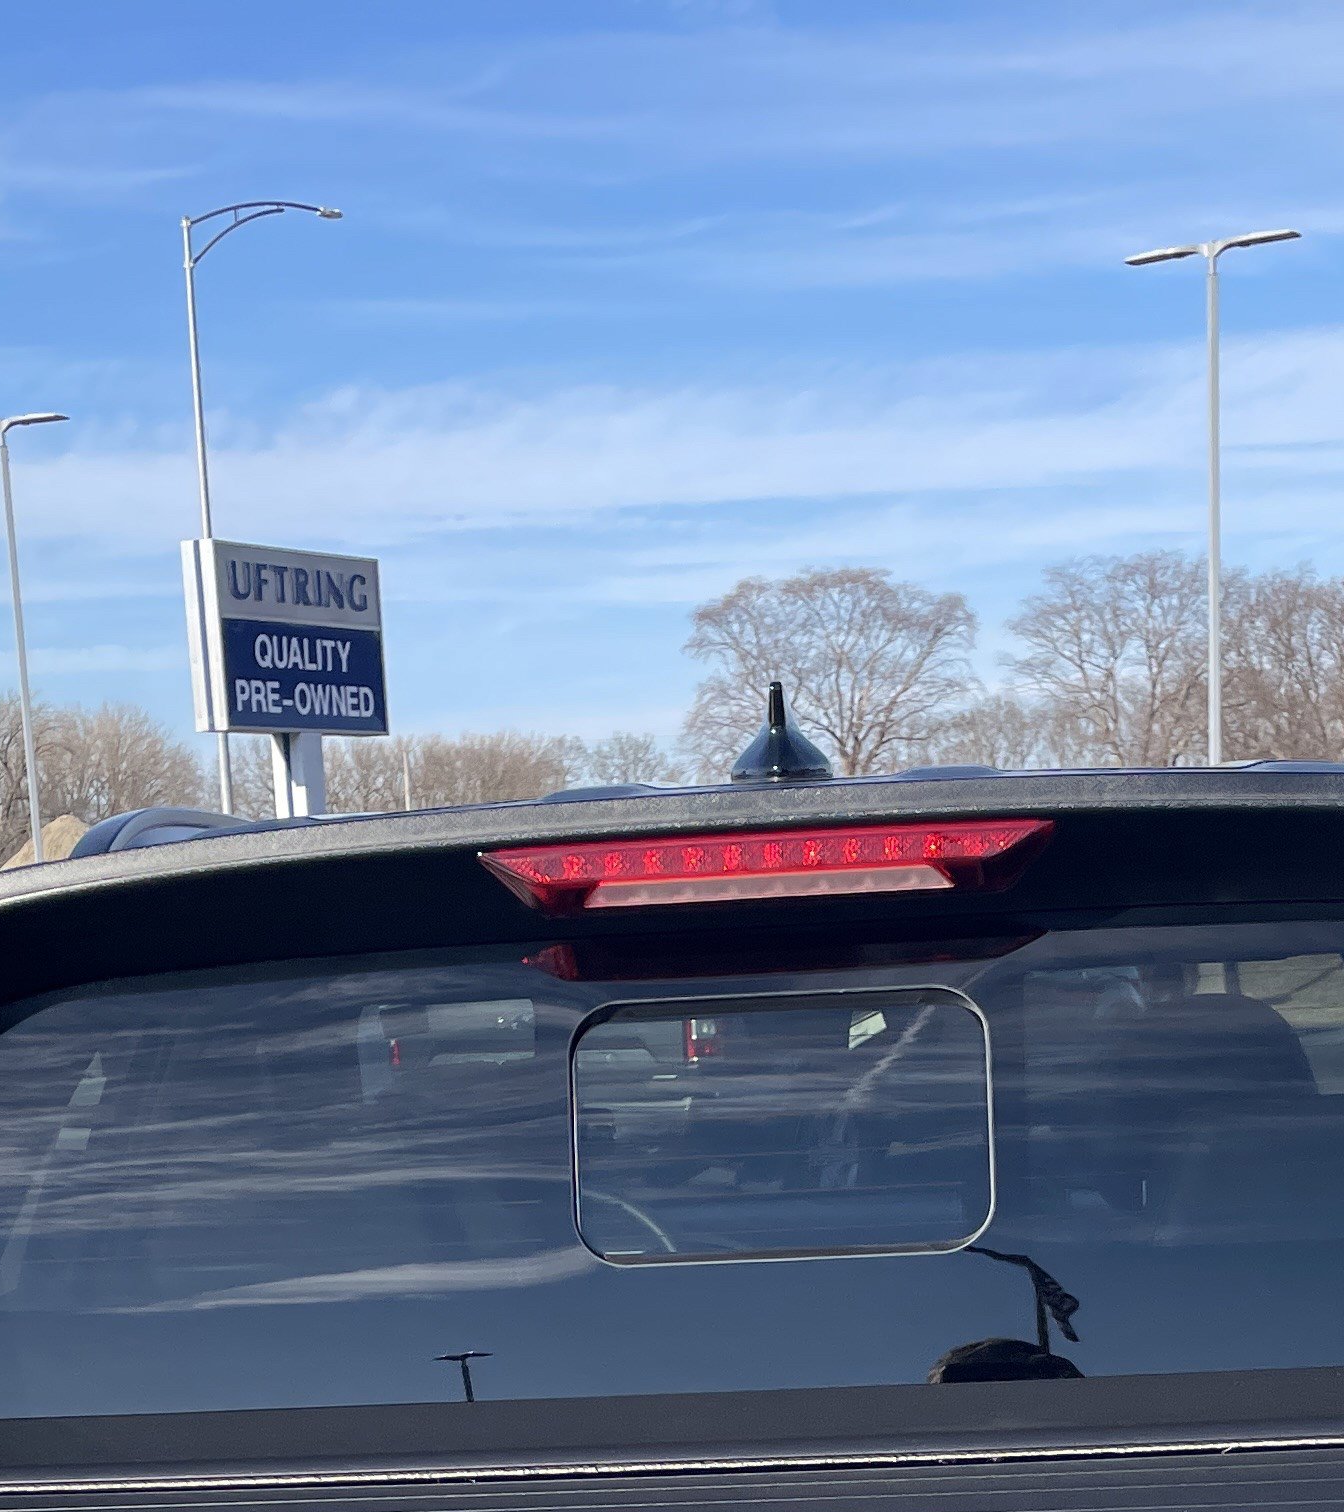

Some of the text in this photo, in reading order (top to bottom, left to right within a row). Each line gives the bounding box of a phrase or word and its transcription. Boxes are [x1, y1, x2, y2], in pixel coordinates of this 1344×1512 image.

[229, 560, 368, 612] UFTRING
[254, 634, 351, 673] QUALITY
[235, 679, 375, 718] PRE-OWNED
